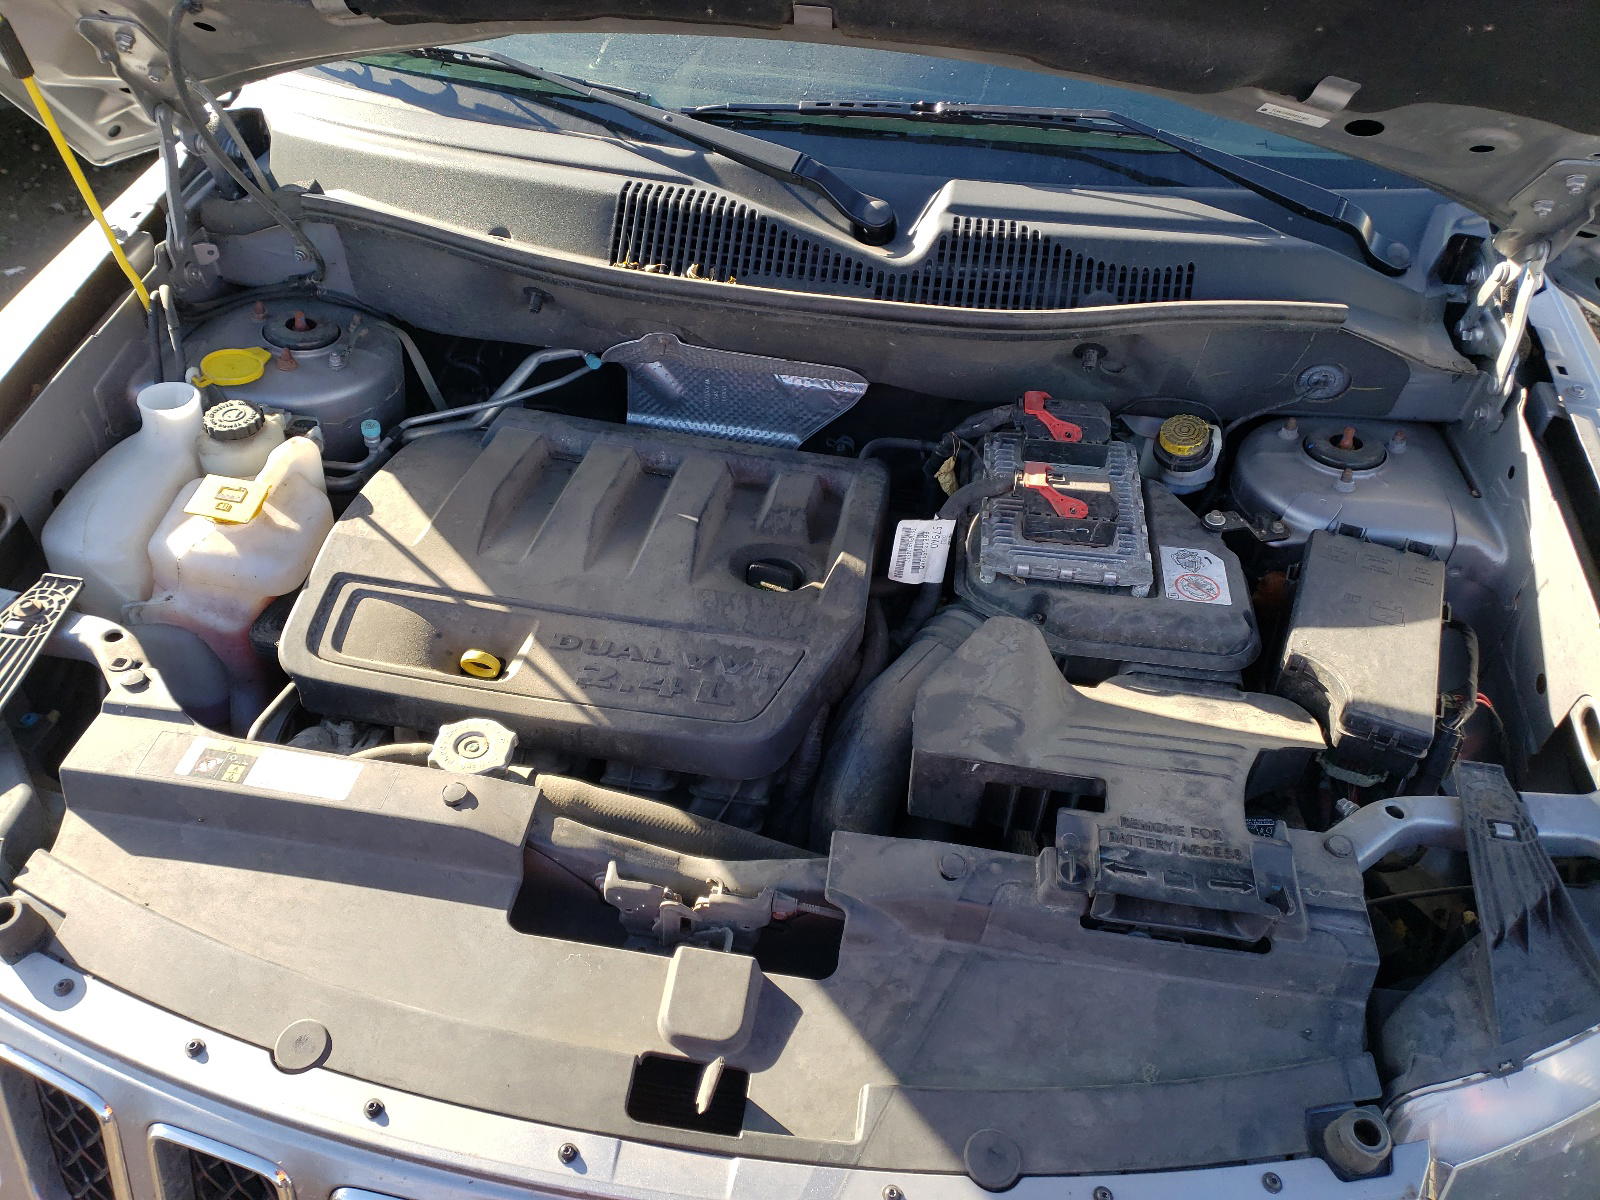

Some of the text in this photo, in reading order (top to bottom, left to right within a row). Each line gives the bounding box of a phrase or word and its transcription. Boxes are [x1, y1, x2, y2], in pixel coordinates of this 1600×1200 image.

[551, 632, 674, 666] DUAL
[1119, 815, 1186, 838] REMOVE
[1190, 826, 1223, 842] FOR
[1108, 831, 1243, 861] BATTERY ACCESS
